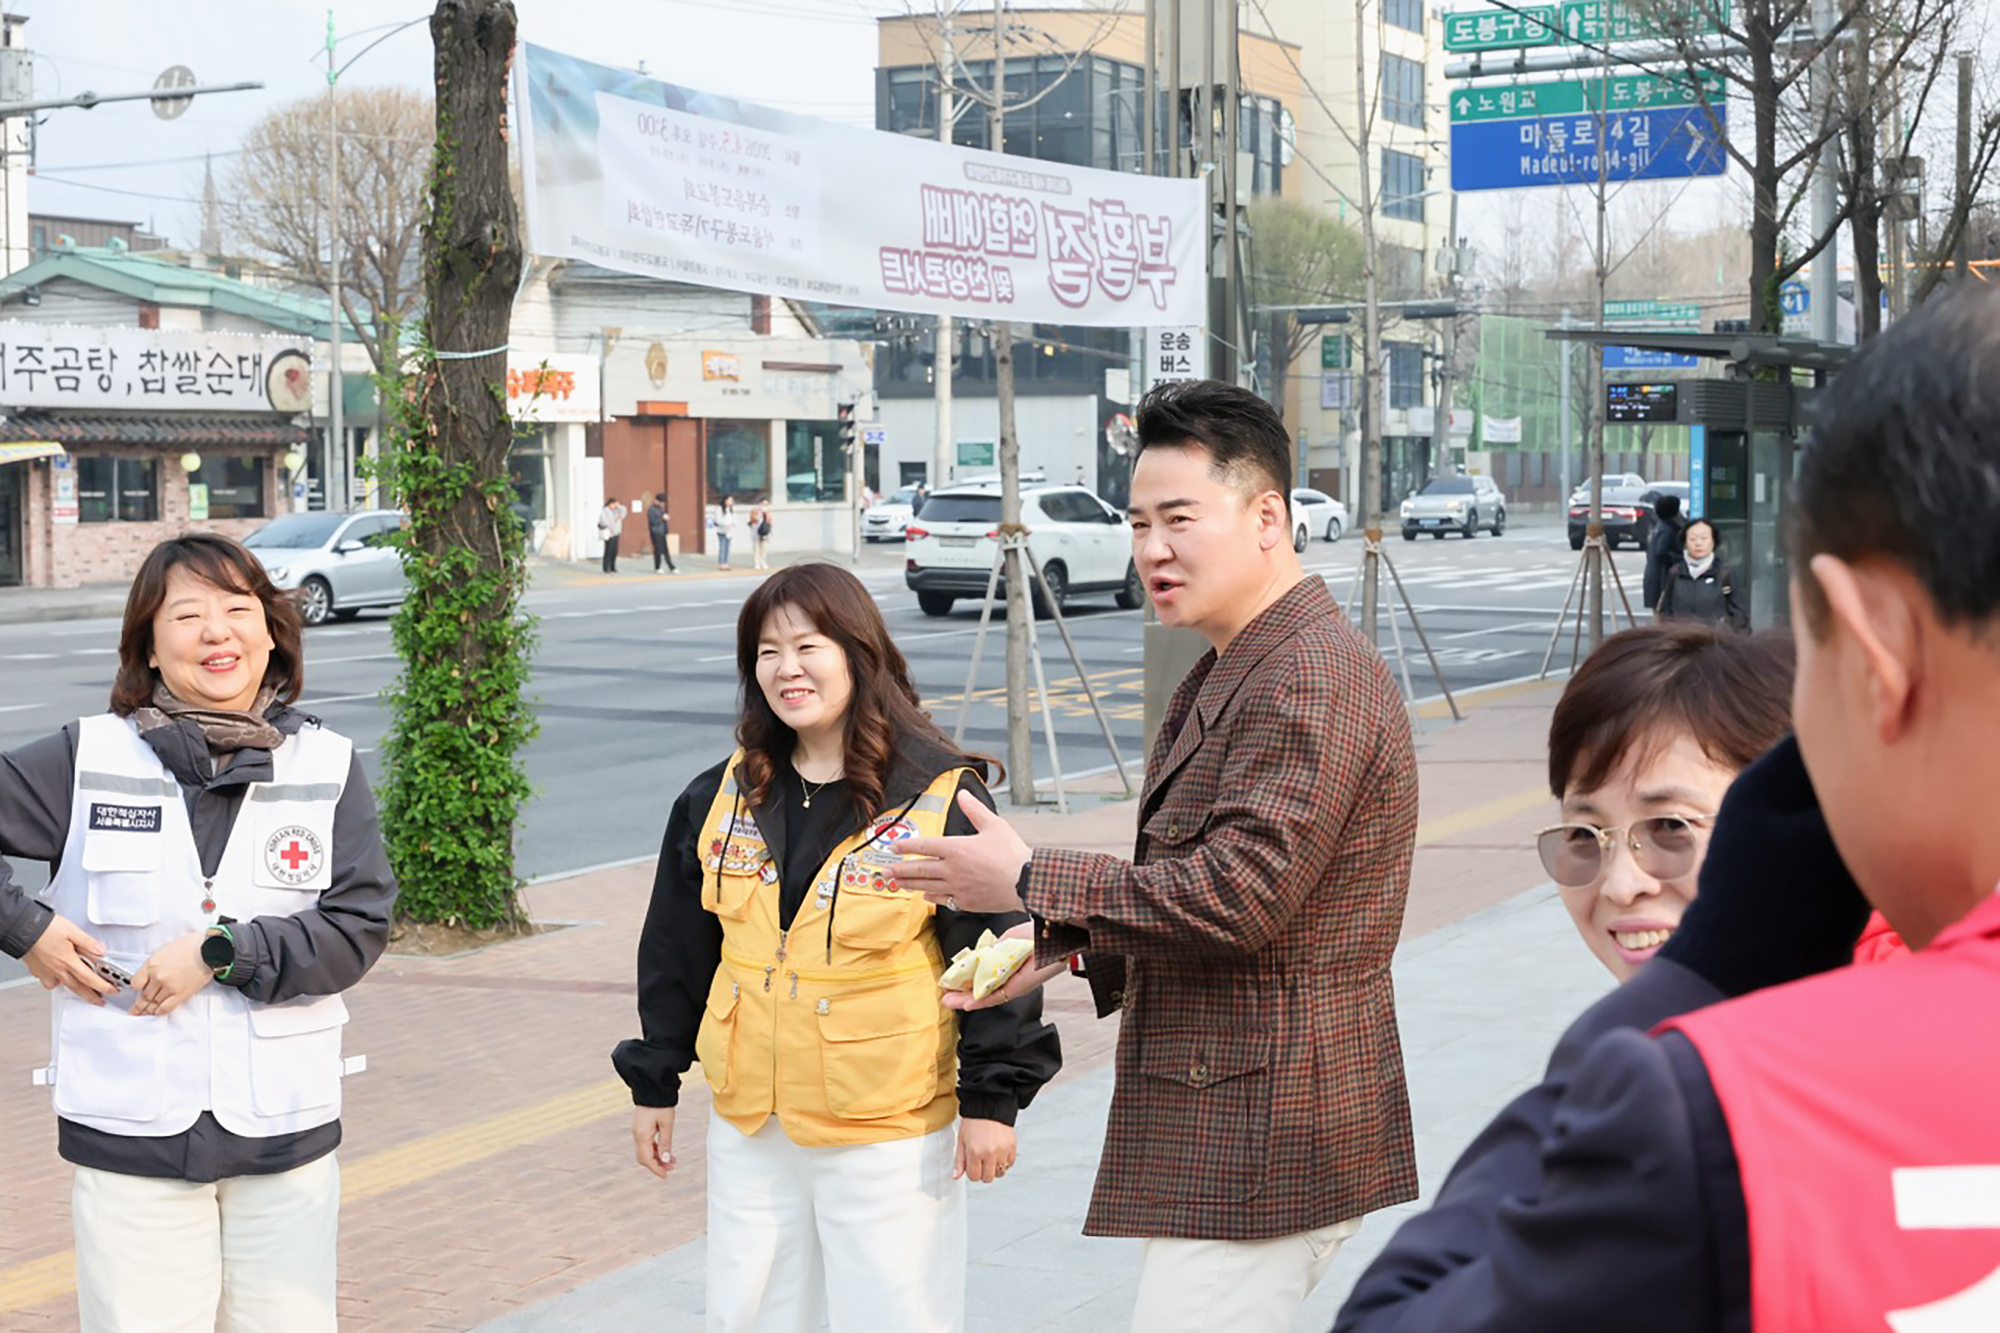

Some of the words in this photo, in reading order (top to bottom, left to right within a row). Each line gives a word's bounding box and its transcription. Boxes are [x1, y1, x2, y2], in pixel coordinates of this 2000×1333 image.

[1452, 11, 1545, 42] 도봉구청
[1477, 89, 1537, 114] 노원교
[1520, 119, 1596, 153] 마들로
[1599, 114, 1650, 147] 4길
[1160, 331, 1191, 351] 운송
[1160, 354, 1191, 373] 버스
